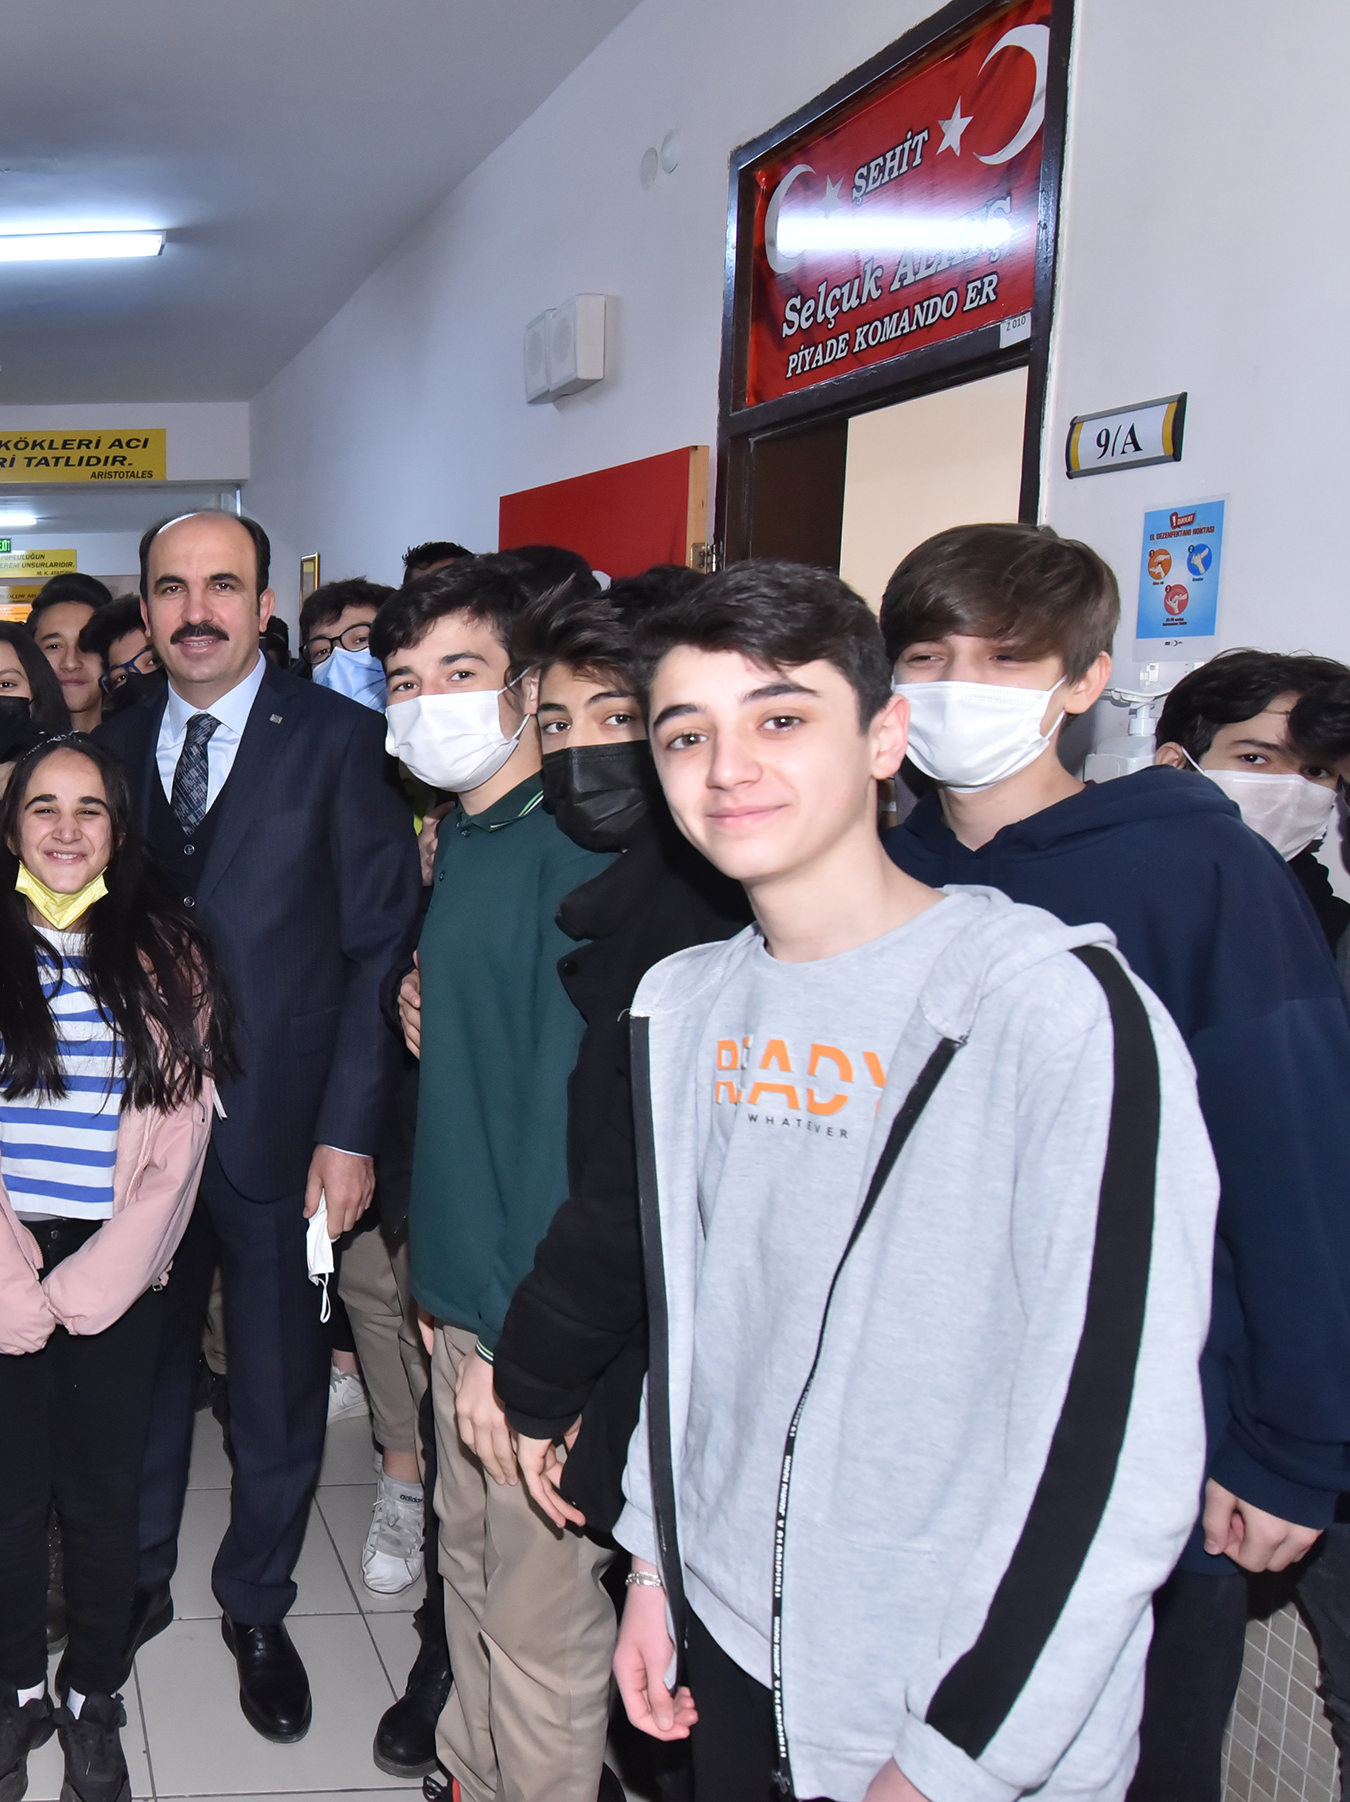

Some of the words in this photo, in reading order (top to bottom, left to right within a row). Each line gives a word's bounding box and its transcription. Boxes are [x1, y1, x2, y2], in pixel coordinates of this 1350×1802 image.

[852, 130, 929, 206] ŞEHİT
[781, 257, 882, 339] Selçuk
[786, 330, 850, 379] PİYADE
[853, 290, 959, 353] KOMANDO
[963, 274, 1000, 312] ER
[1012, 316, 1026, 329] 010
[108, 438, 149, 449] ACI
[1096, 423, 1143, 460] 9/A
[25, 455, 133, 467] TATLIDIR.
[89, 470, 154, 479] ARİSTOTALES
[715, 1036, 886, 1116] RAD
[748, 1113, 849, 1139] WHATEVER
